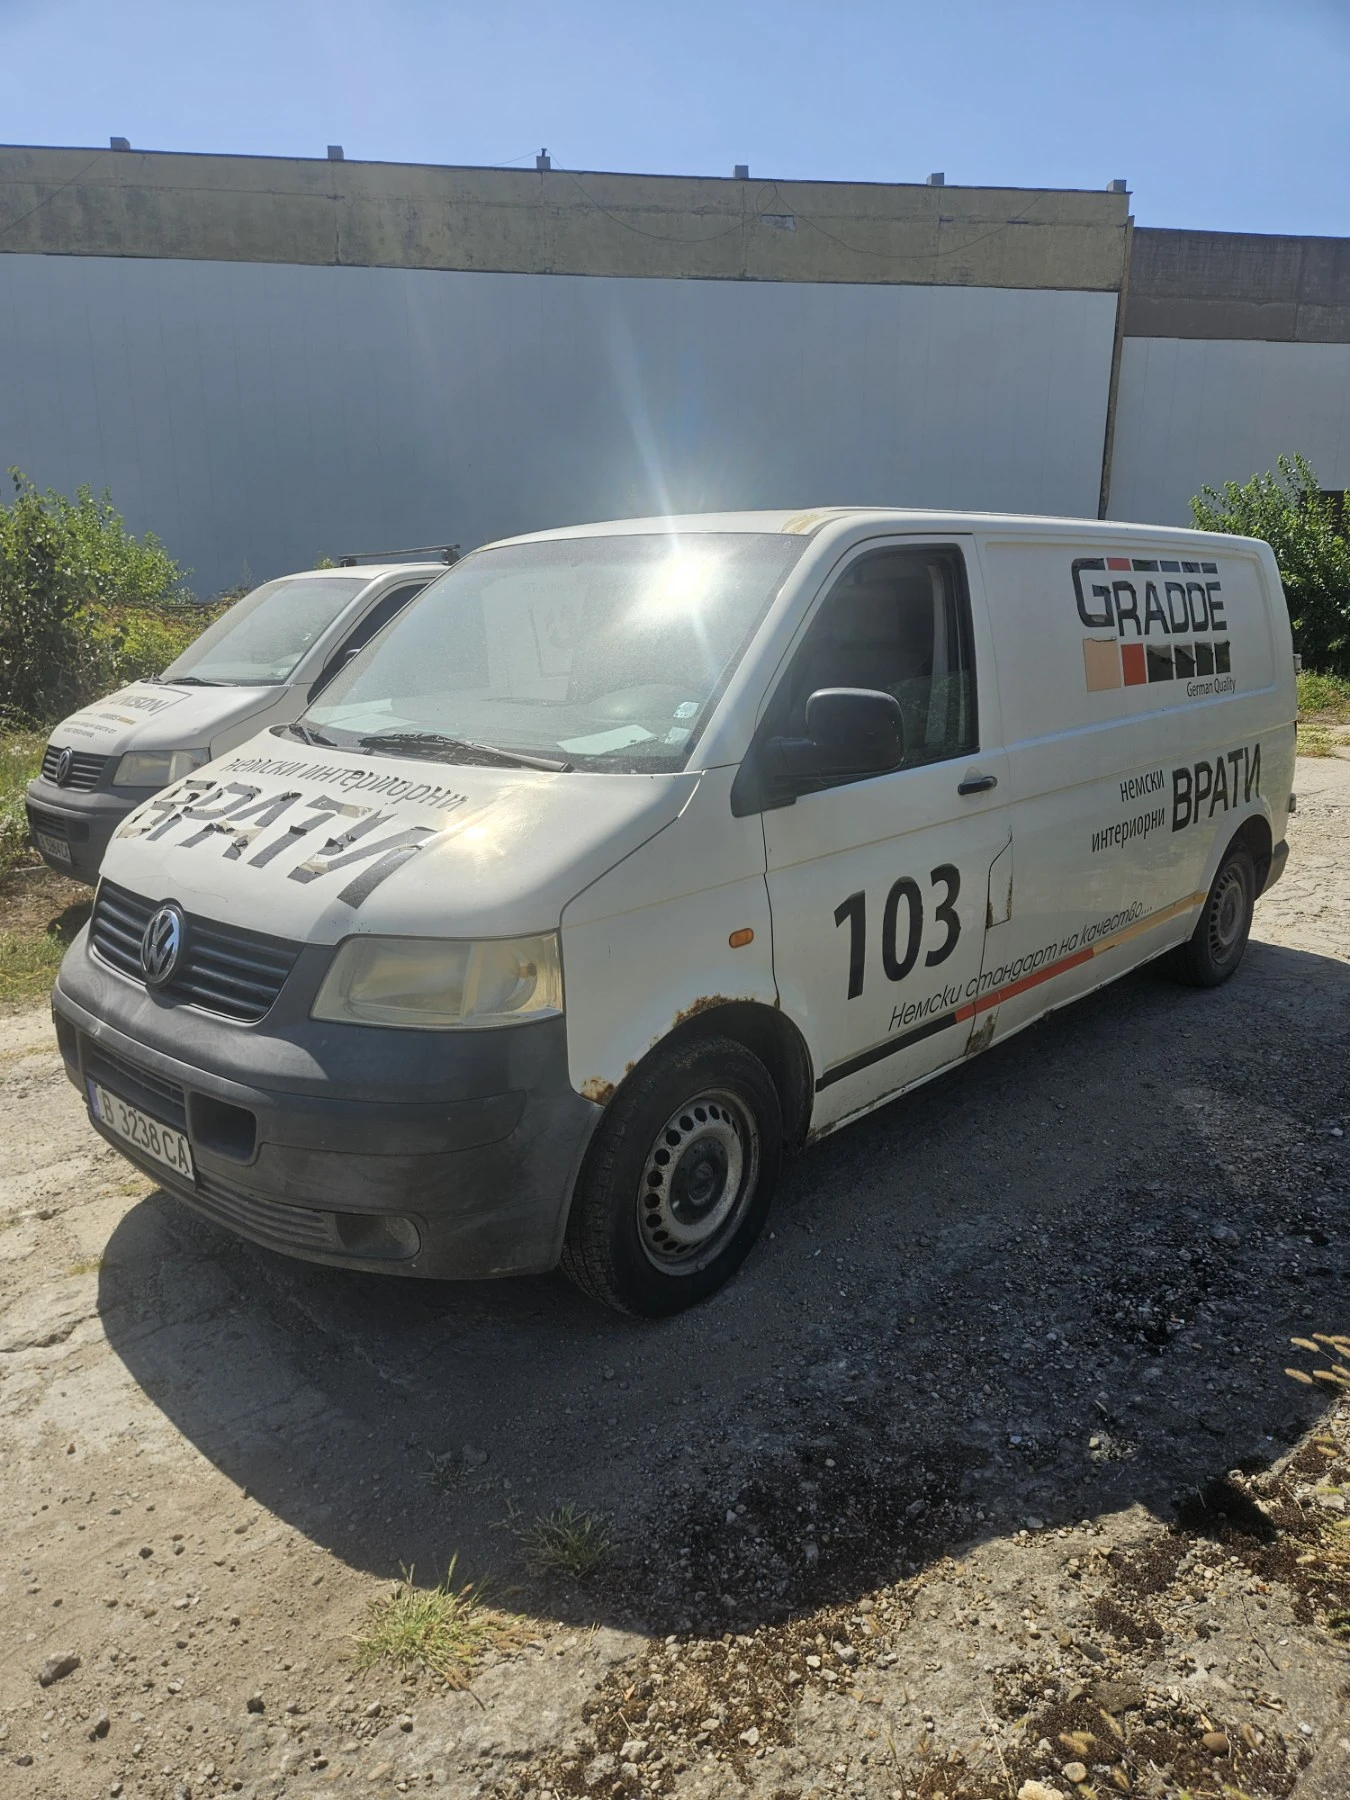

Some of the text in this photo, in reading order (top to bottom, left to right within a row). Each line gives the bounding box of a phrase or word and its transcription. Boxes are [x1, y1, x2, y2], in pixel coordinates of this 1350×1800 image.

[1071, 557, 1228, 637] GRADDE
[1186, 676, 1237, 697] German Quality
[220, 757, 469, 813] немски интериорни
[1120, 769, 1165, 803] немски
[1171, 743, 1261, 833] ВРАТИ
[1091, 807, 1166, 853] интериорни
[833, 862, 962, 1001] 103
[887, 984, 963, 1032] Немски
[965, 942, 1058, 998] стандарт
[1060, 932, 1079, 957] на
[101, 1090, 114, 1125] B
